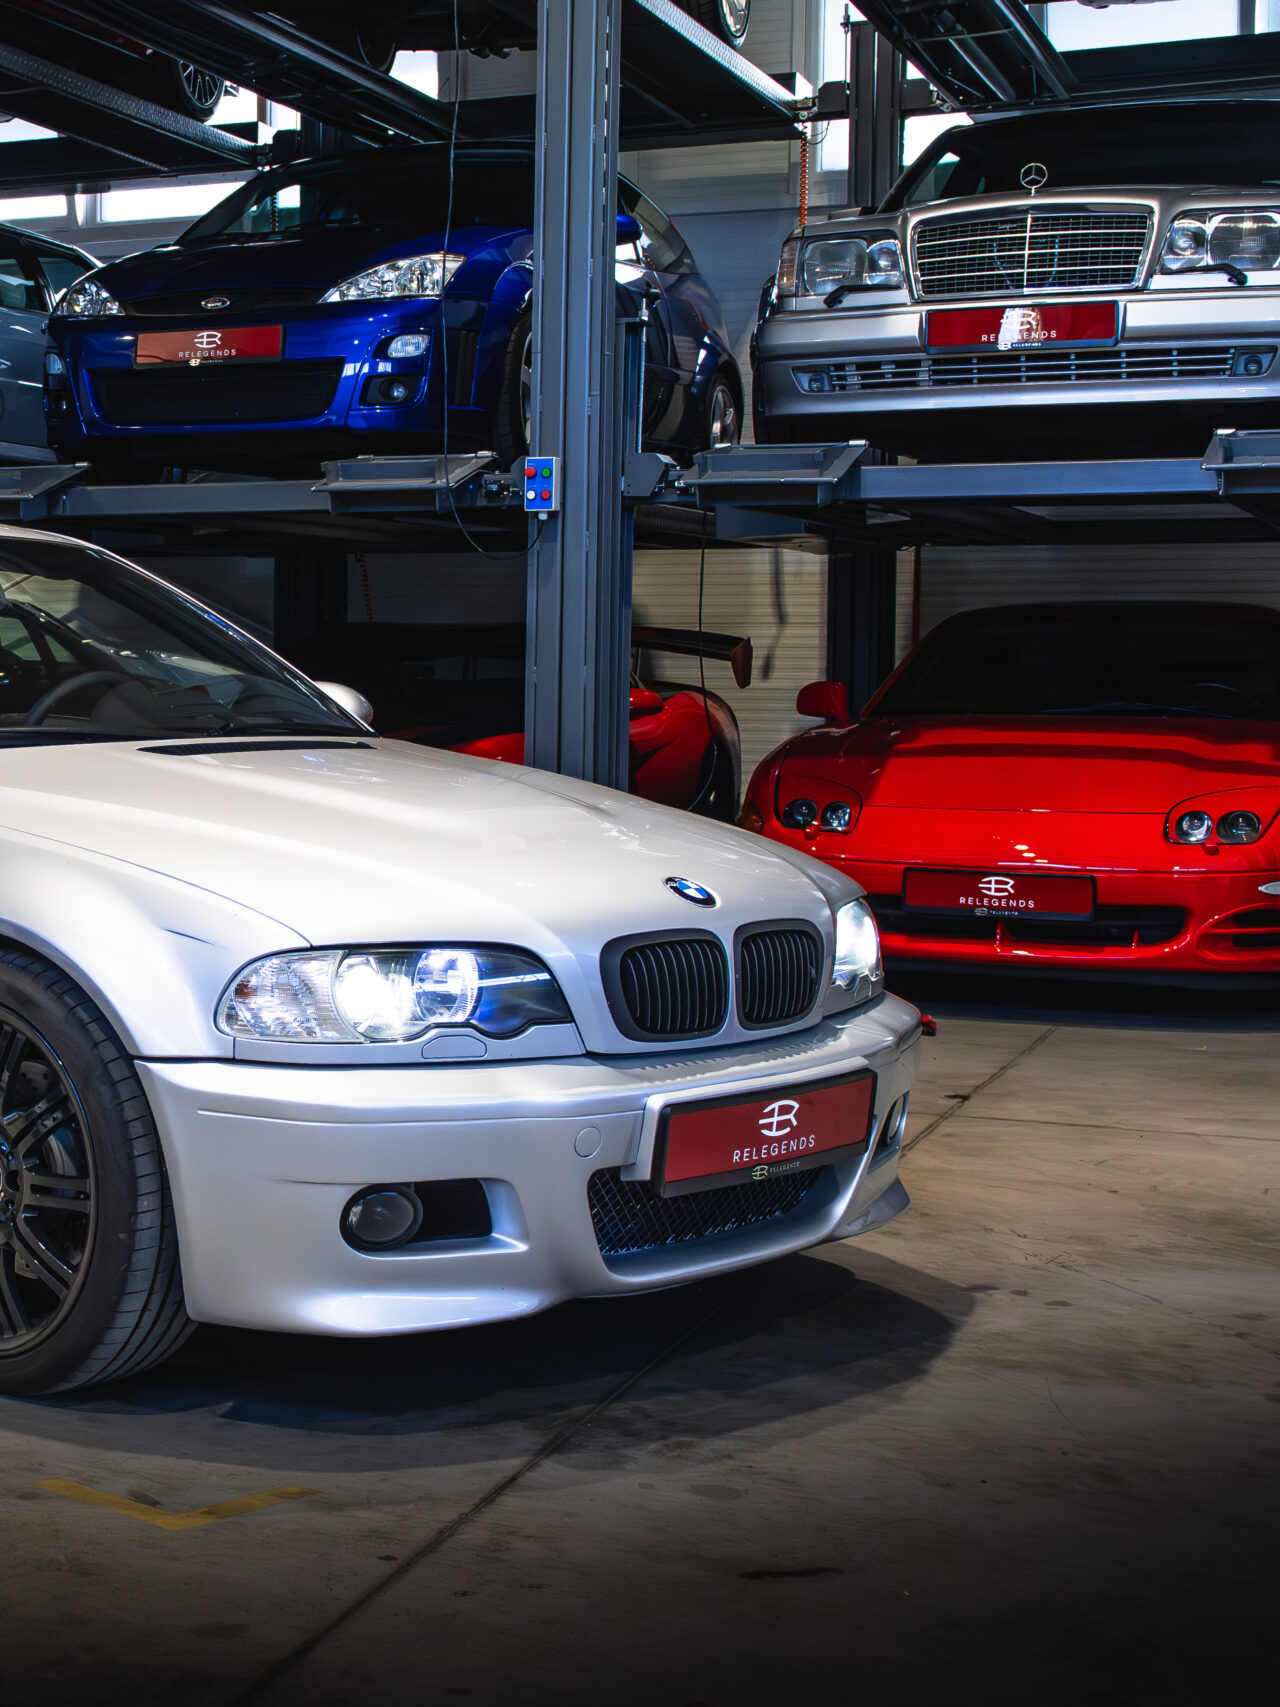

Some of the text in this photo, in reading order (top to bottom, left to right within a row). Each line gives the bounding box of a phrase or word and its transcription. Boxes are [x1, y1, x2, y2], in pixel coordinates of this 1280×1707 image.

[178, 349, 237, 358] RELEGENDS
[959, 896, 1035, 908] RELEGENDS
[733, 1134, 816, 1163] RELEGENDS
